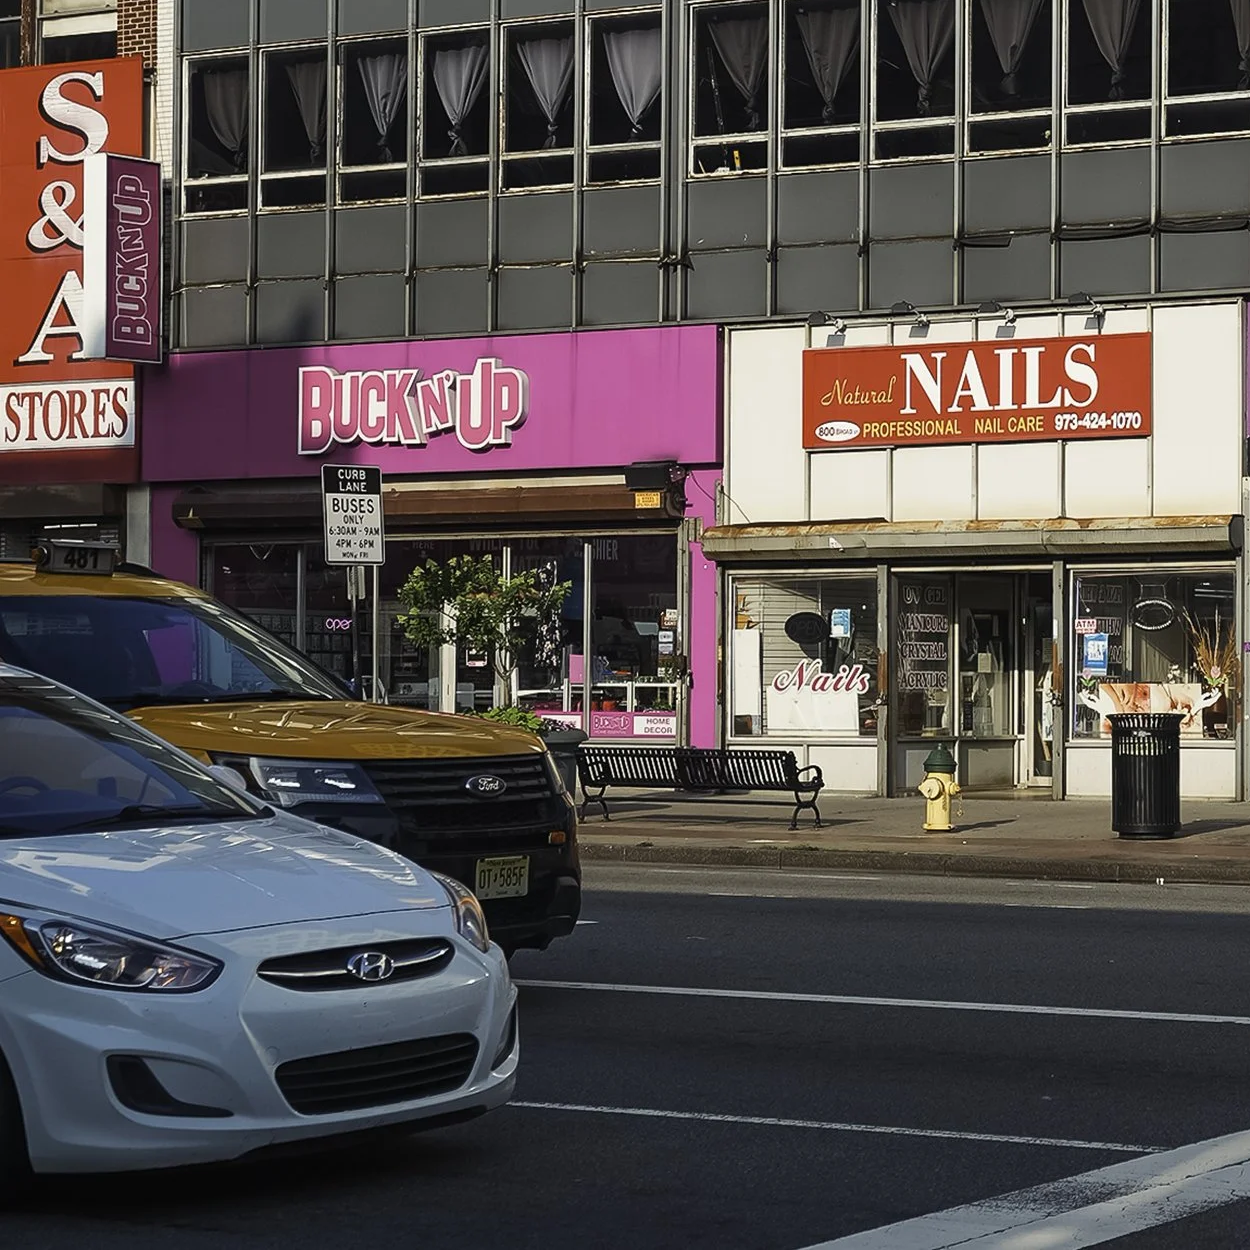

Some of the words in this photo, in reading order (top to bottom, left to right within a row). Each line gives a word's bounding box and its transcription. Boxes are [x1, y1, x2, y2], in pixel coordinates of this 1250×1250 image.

[820, 375, 897, 406] Natural
[900, 343, 1099, 415] NAILS
[4, 386, 129, 442] STORES
[862, 419, 962, 438] PROFESSIONAL
[974, 417, 1005, 434] NAIL
[1007, 415, 1044, 433] CARE
[1053, 411, 1142, 432] 973-424-1070
[338, 469, 366, 480] CURB
[339, 481, 367, 492] LANE
[332, 497, 375, 514] BUSES
[343, 515, 364, 525] ONLY
[329, 526, 357, 536] 6:30AM
[363, 527, 380, 536] 9AM
[335, 539, 352, 548] 4PM
[358, 539, 374, 549] 6PM
[64, 548, 99, 569] 481
[900, 613, 949, 633] MANICURE
[1076, 620, 1096, 628] ATM
[900, 641, 948, 660] CRYSTAL
[772, 658, 871, 696] Nails
[900, 671, 948, 689] ACRYLIC
[646, 717, 671, 725] HOME
[644, 726, 672, 734] DECOR
[479, 777, 499, 790] Ford
